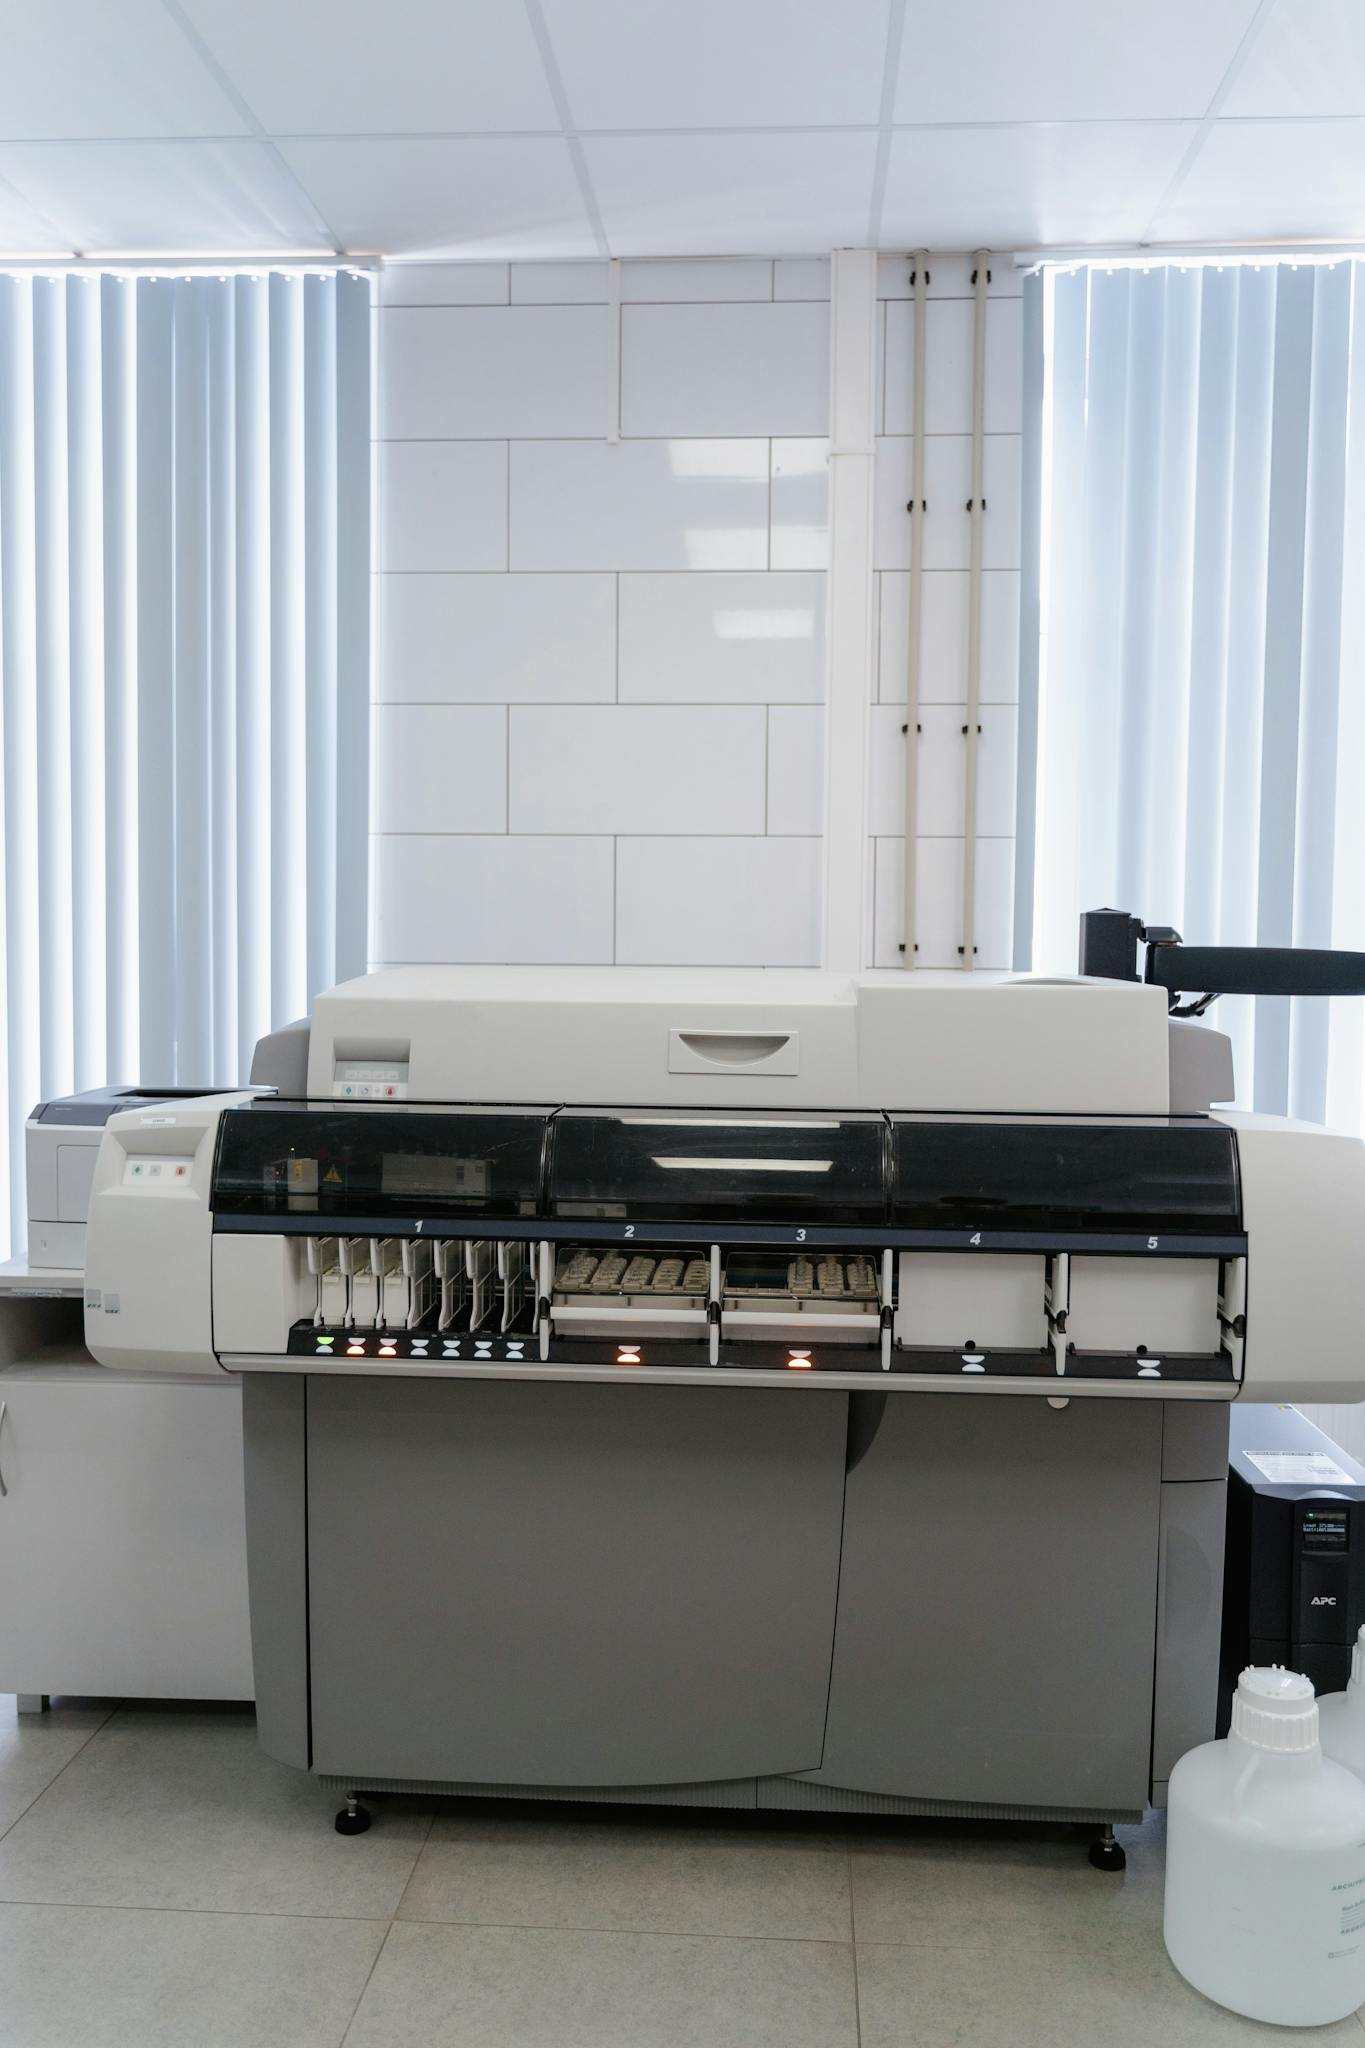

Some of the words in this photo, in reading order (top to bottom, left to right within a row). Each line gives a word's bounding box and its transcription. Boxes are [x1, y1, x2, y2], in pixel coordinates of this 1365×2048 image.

[414, 1219, 424, 1233] 1
[623, 1225, 635, 1238] 2
[795, 1228, 807, 1242] 3
[969, 1232, 982, 1246] 4
[1146, 1236, 1159, 1250] 5
[1311, 1596, 1337, 1606] APC
